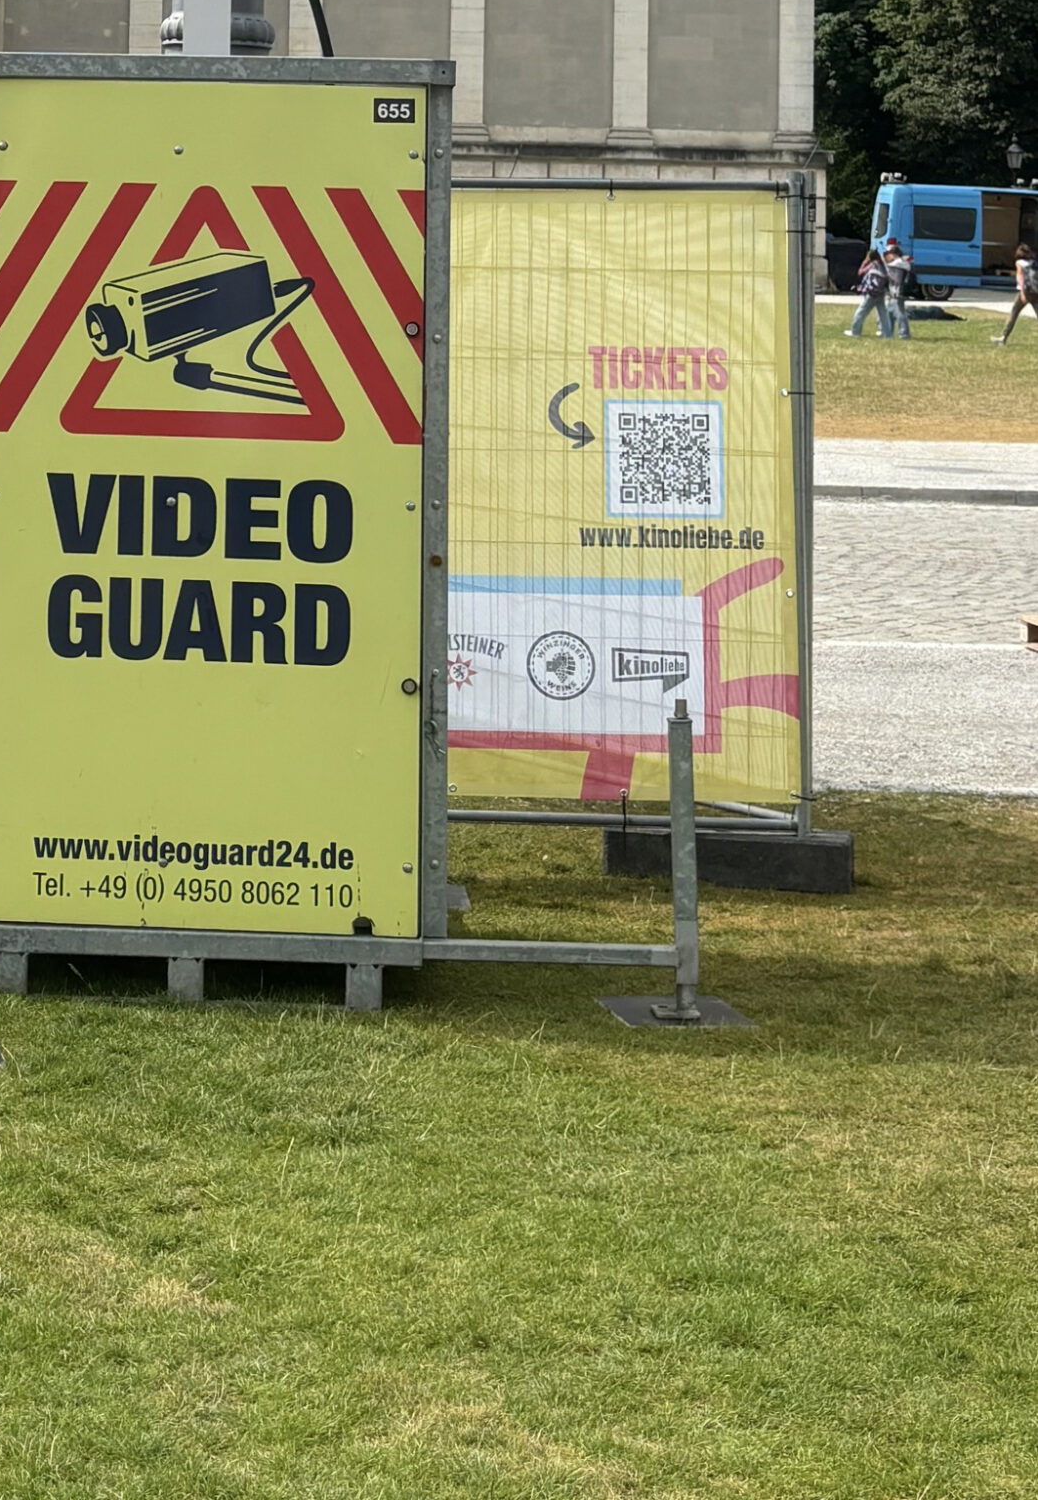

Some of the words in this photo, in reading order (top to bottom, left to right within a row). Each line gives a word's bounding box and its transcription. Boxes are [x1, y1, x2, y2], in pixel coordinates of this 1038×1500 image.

[377, 101, 411, 120] 655
[587, 345, 730, 392] TICKETS
[47, 472, 354, 564] VIDEO
[579, 524, 766, 551] www.kinoliebe.de
[47, 574, 351, 666] GUARD
[448, 633, 505, 660] LSTEINER
[618, 652, 685, 676] kinoliebe
[34, 834, 354, 870] www.videoguard24.de
[32, 872, 71, 897] Tel.
[80, 875, 127, 899] +49
[136, 873, 165, 902] (0)
[173, 878, 232, 903] 4950
[241, 880, 299, 905] 8062
[310, 883, 353, 908] 110
